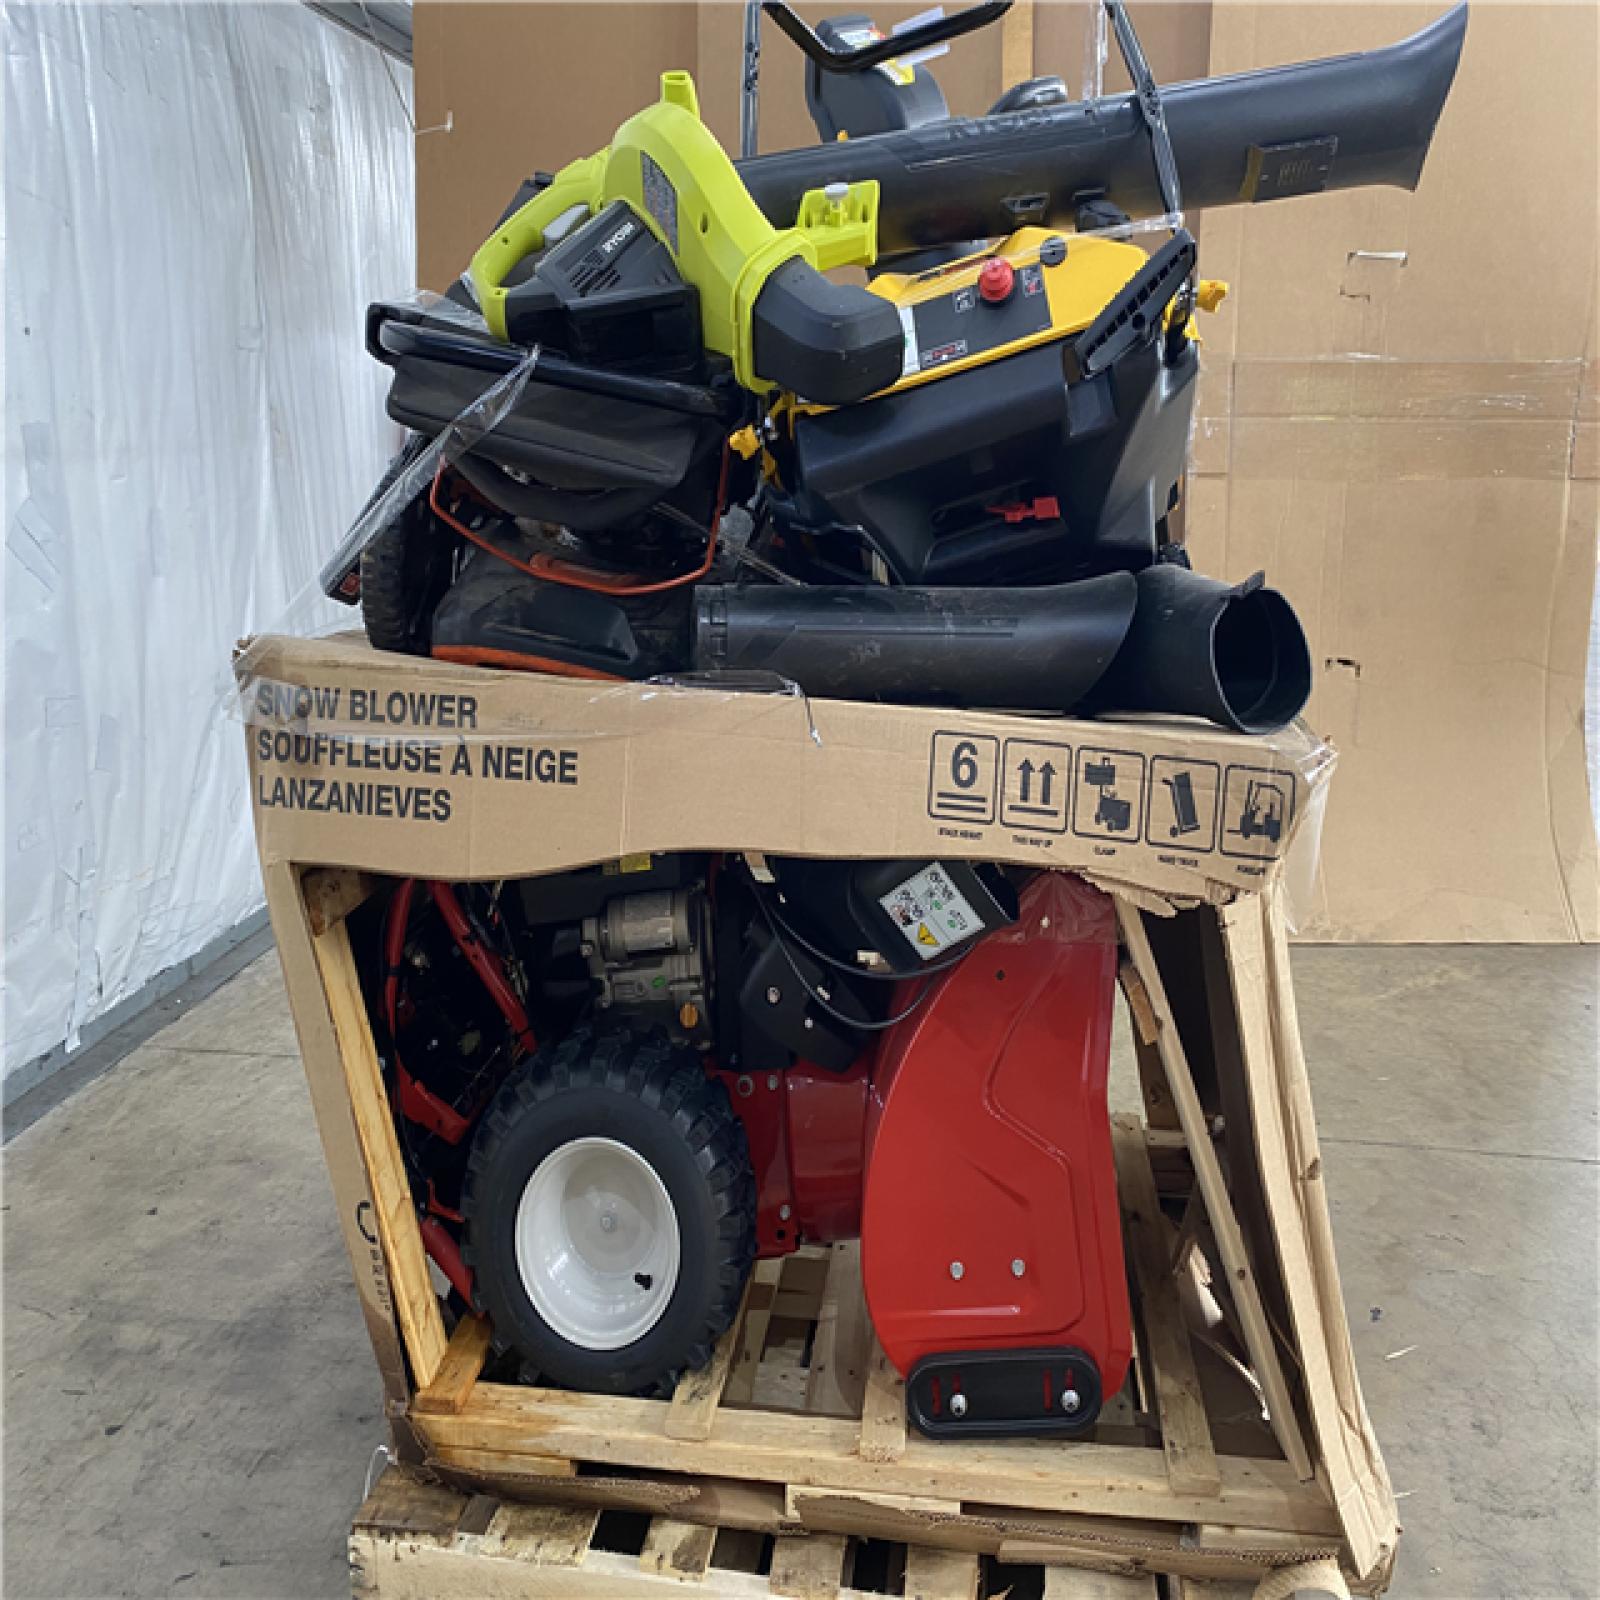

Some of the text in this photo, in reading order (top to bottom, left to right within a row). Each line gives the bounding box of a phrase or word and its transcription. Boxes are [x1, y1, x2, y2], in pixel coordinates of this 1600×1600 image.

[257, 684, 477, 729] SNOW BLOWER
[258, 729, 579, 785] SOUFFLEUSE À NEIGE
[951, 741, 978, 789] 6
[259, 774, 451, 822] LANZANIEVES
